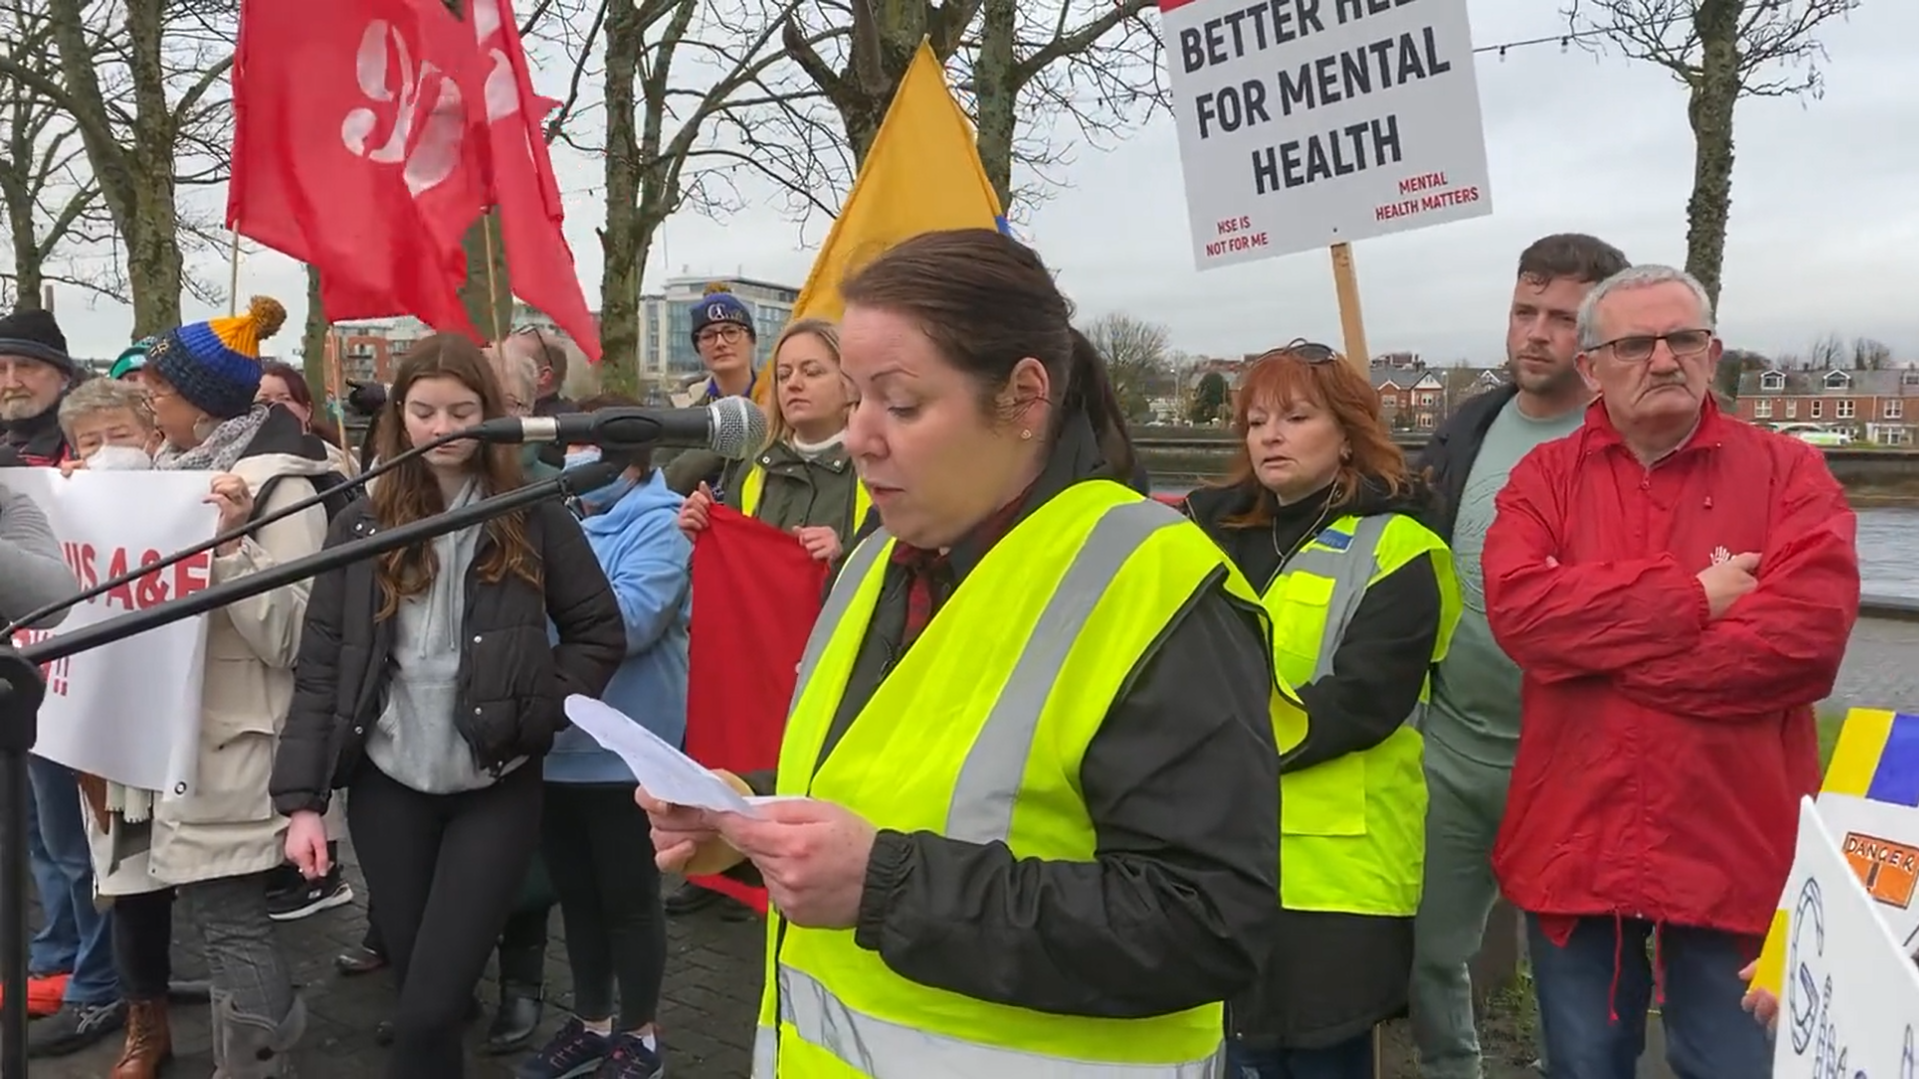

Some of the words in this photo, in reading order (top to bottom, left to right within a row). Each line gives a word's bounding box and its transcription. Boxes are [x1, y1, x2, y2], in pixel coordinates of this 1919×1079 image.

[1180, 0, 1325, 74] BETTER
[1196, 79, 1271, 140] FOR
[1278, 26, 1451, 116] MENTAL
[1252, 114, 1402, 195] HEALTH
[1399, 172, 1448, 195] MENTAL
[1375, 200, 1419, 221] HEALTH
[1421, 187, 1479, 211] MATTERS
[1217, 217, 1238, 235] HSE
[1239, 215, 1251, 229] IS
[1206, 240, 1228, 257] NOT
[1229, 236, 1250, 253] FOR
[1251, 232, 1268, 247] ME
